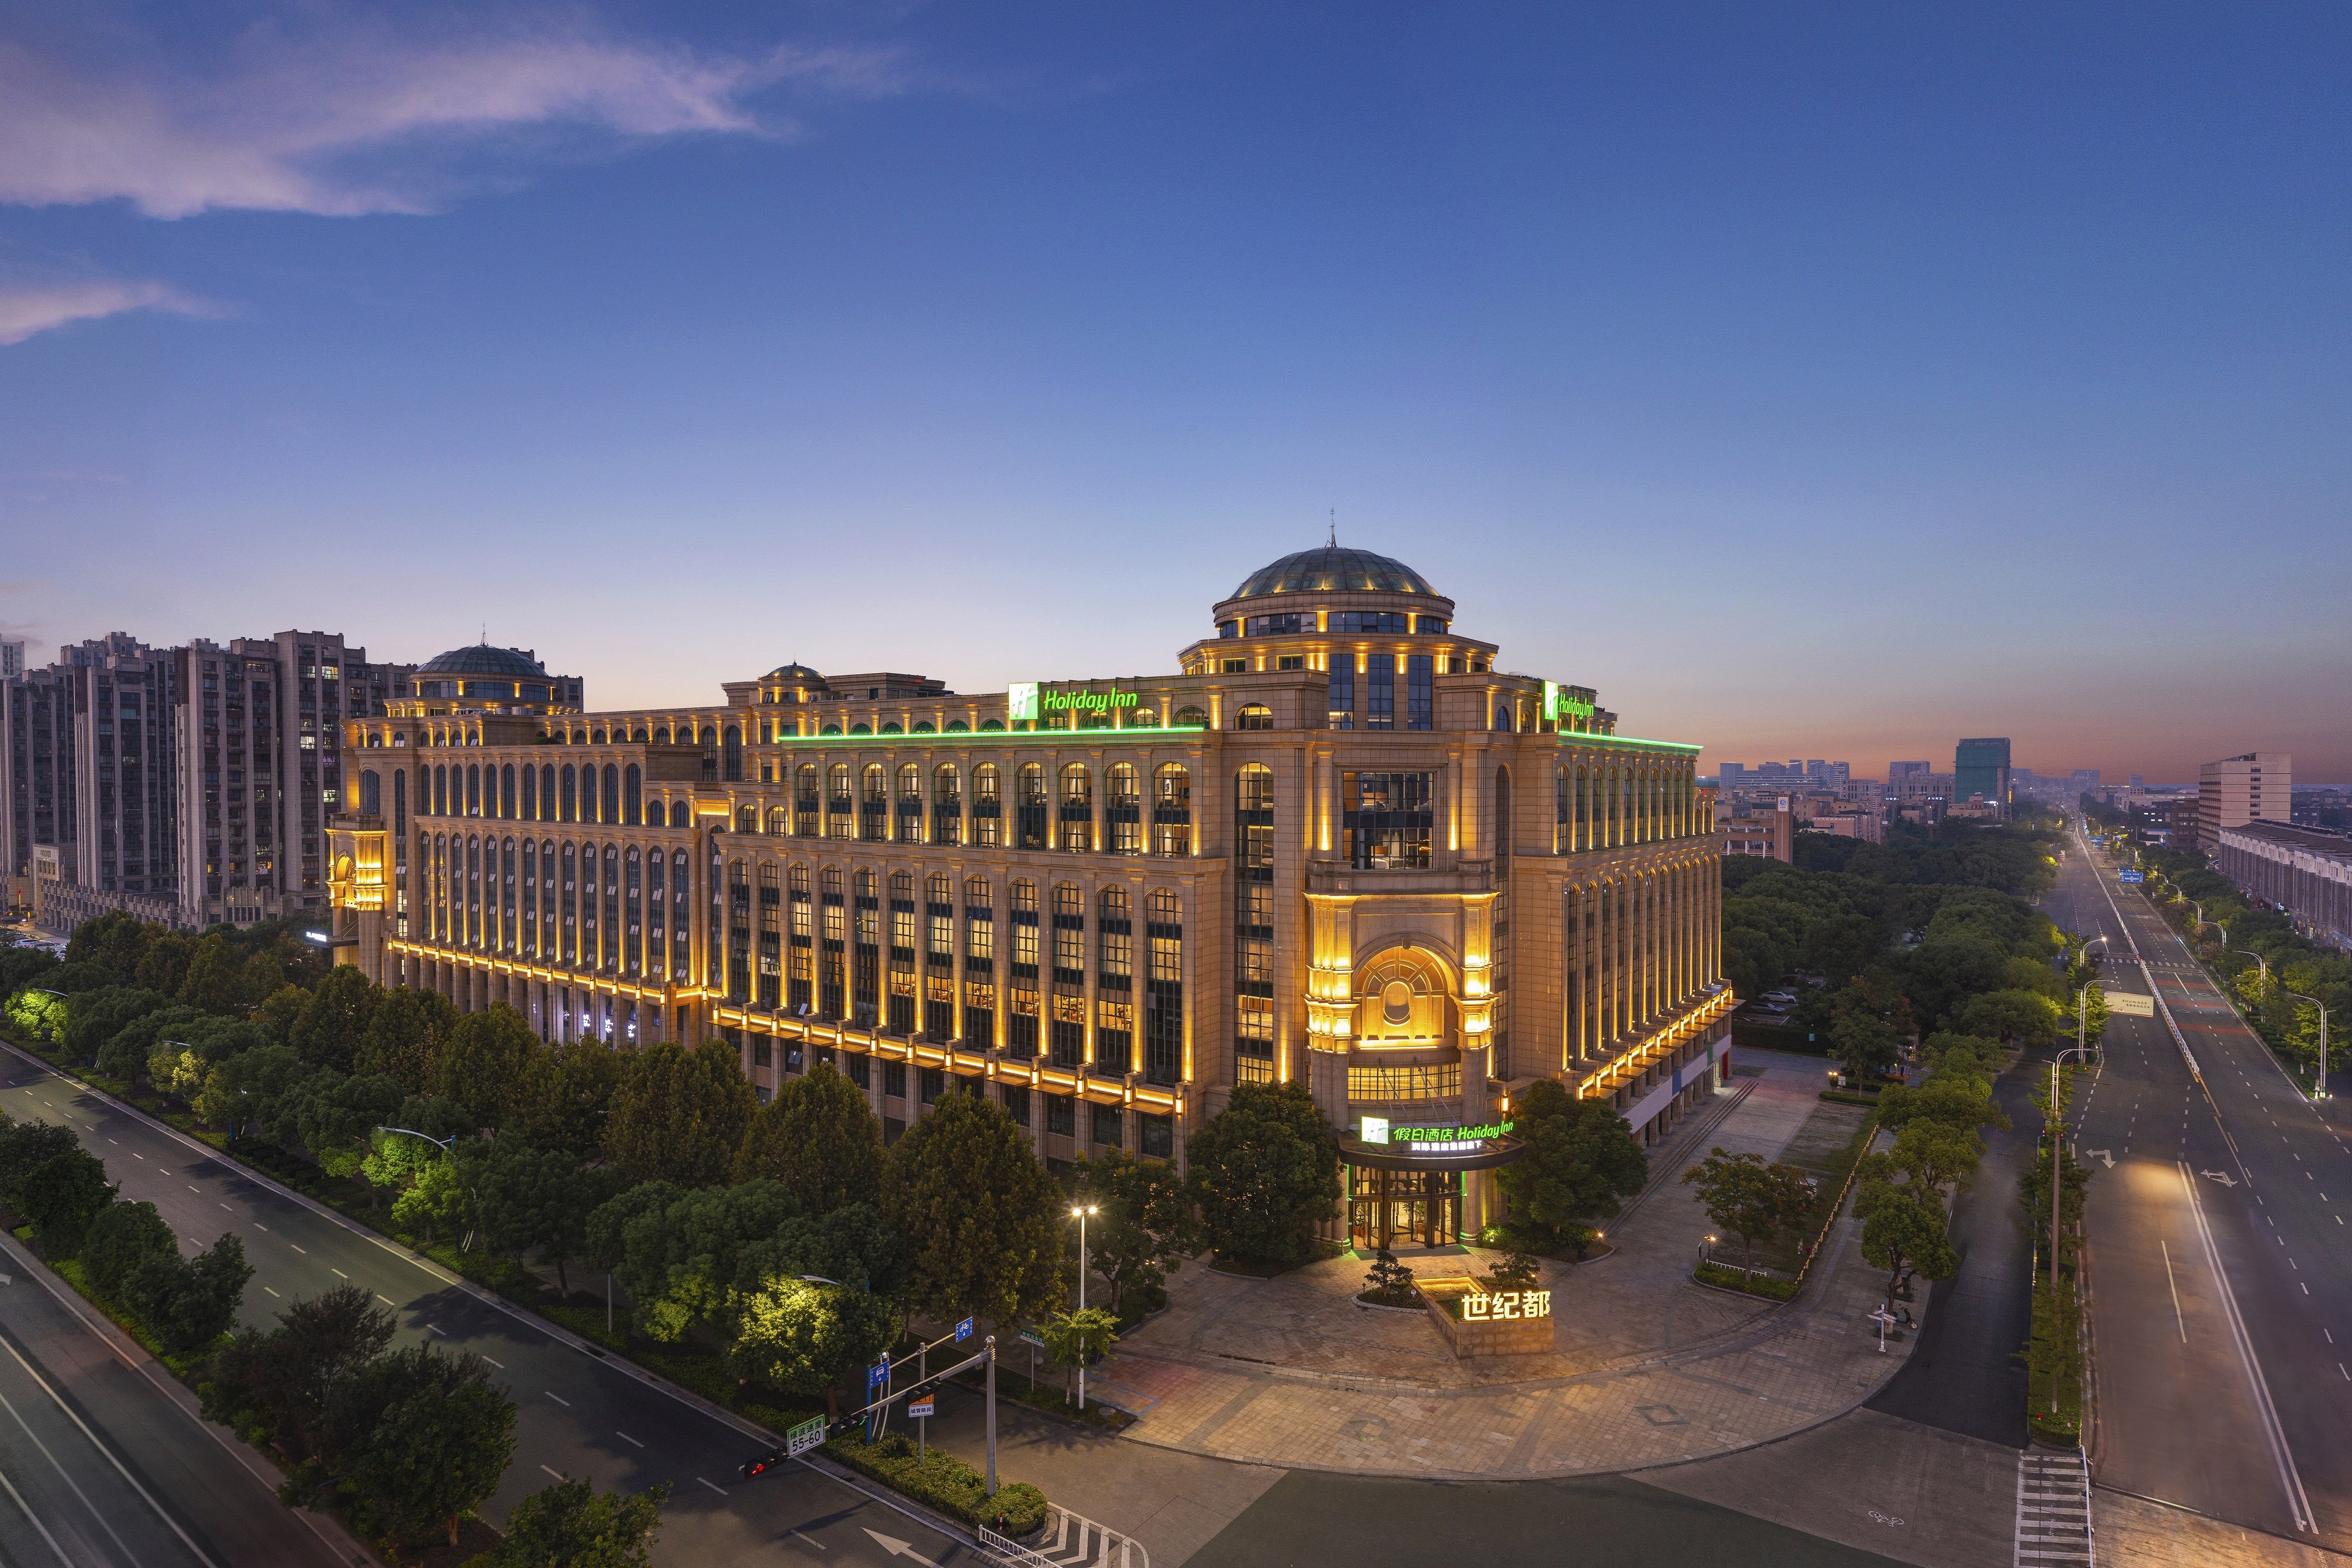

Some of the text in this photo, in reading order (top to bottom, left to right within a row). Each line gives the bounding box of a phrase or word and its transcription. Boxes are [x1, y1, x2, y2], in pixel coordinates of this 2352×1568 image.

[1044, 687, 1137, 713] Holiday Inn
[1559, 693, 1594, 720] Holiday Inn
[1393, 1120, 1513, 1142] 假日酒店 Holiday Inn
[1461, 1290, 1551, 1321] 世纪都
[790, 1420, 822, 1441] 绿波速度
[792, 1430, 821, 1452] 55-60
